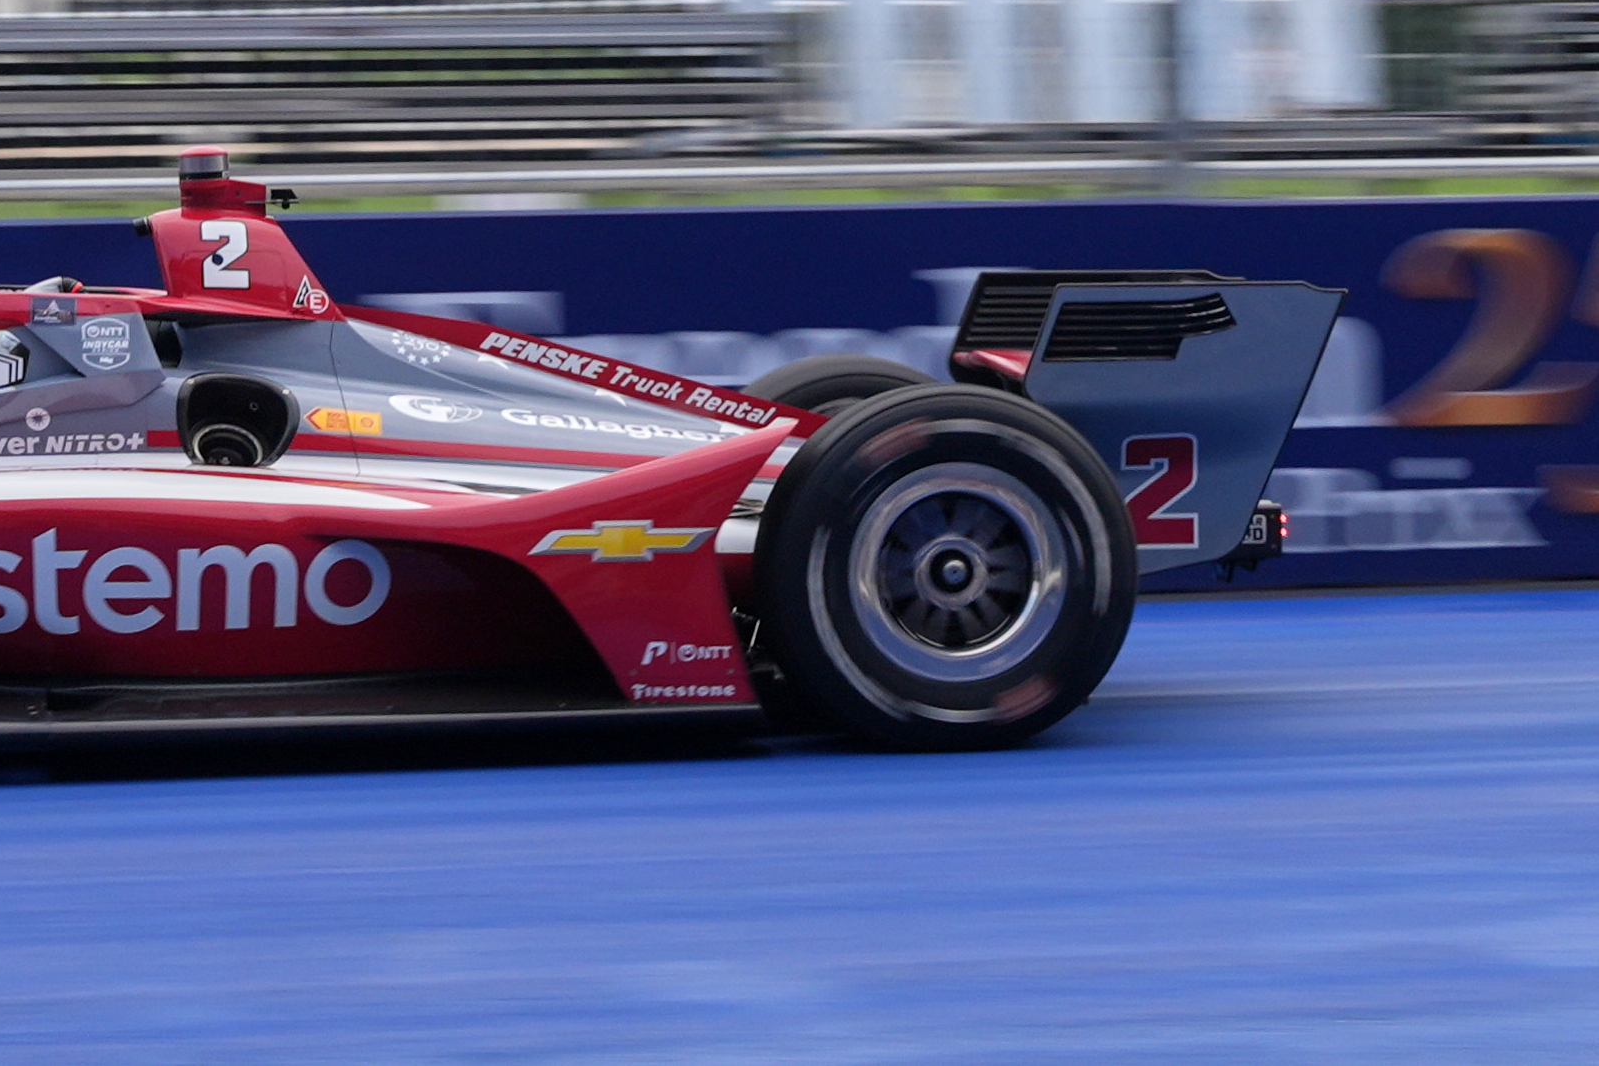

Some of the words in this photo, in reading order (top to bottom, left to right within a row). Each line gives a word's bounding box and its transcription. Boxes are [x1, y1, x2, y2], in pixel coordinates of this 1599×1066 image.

[201, 220, 250, 289] 2
[100, 326, 124, 338] NTT
[82, 340, 130, 350] INDYCAR
[479, 331, 609, 380] PENSKE
[609, 365, 685, 402] Truck
[685, 388, 777, 425] Rental
[501, 408, 733, 442] Gallagher
[1121, 432, 1199, 550] 2
[696, 645, 734, 660] NTT
[630, 683, 737, 700] Firestone
